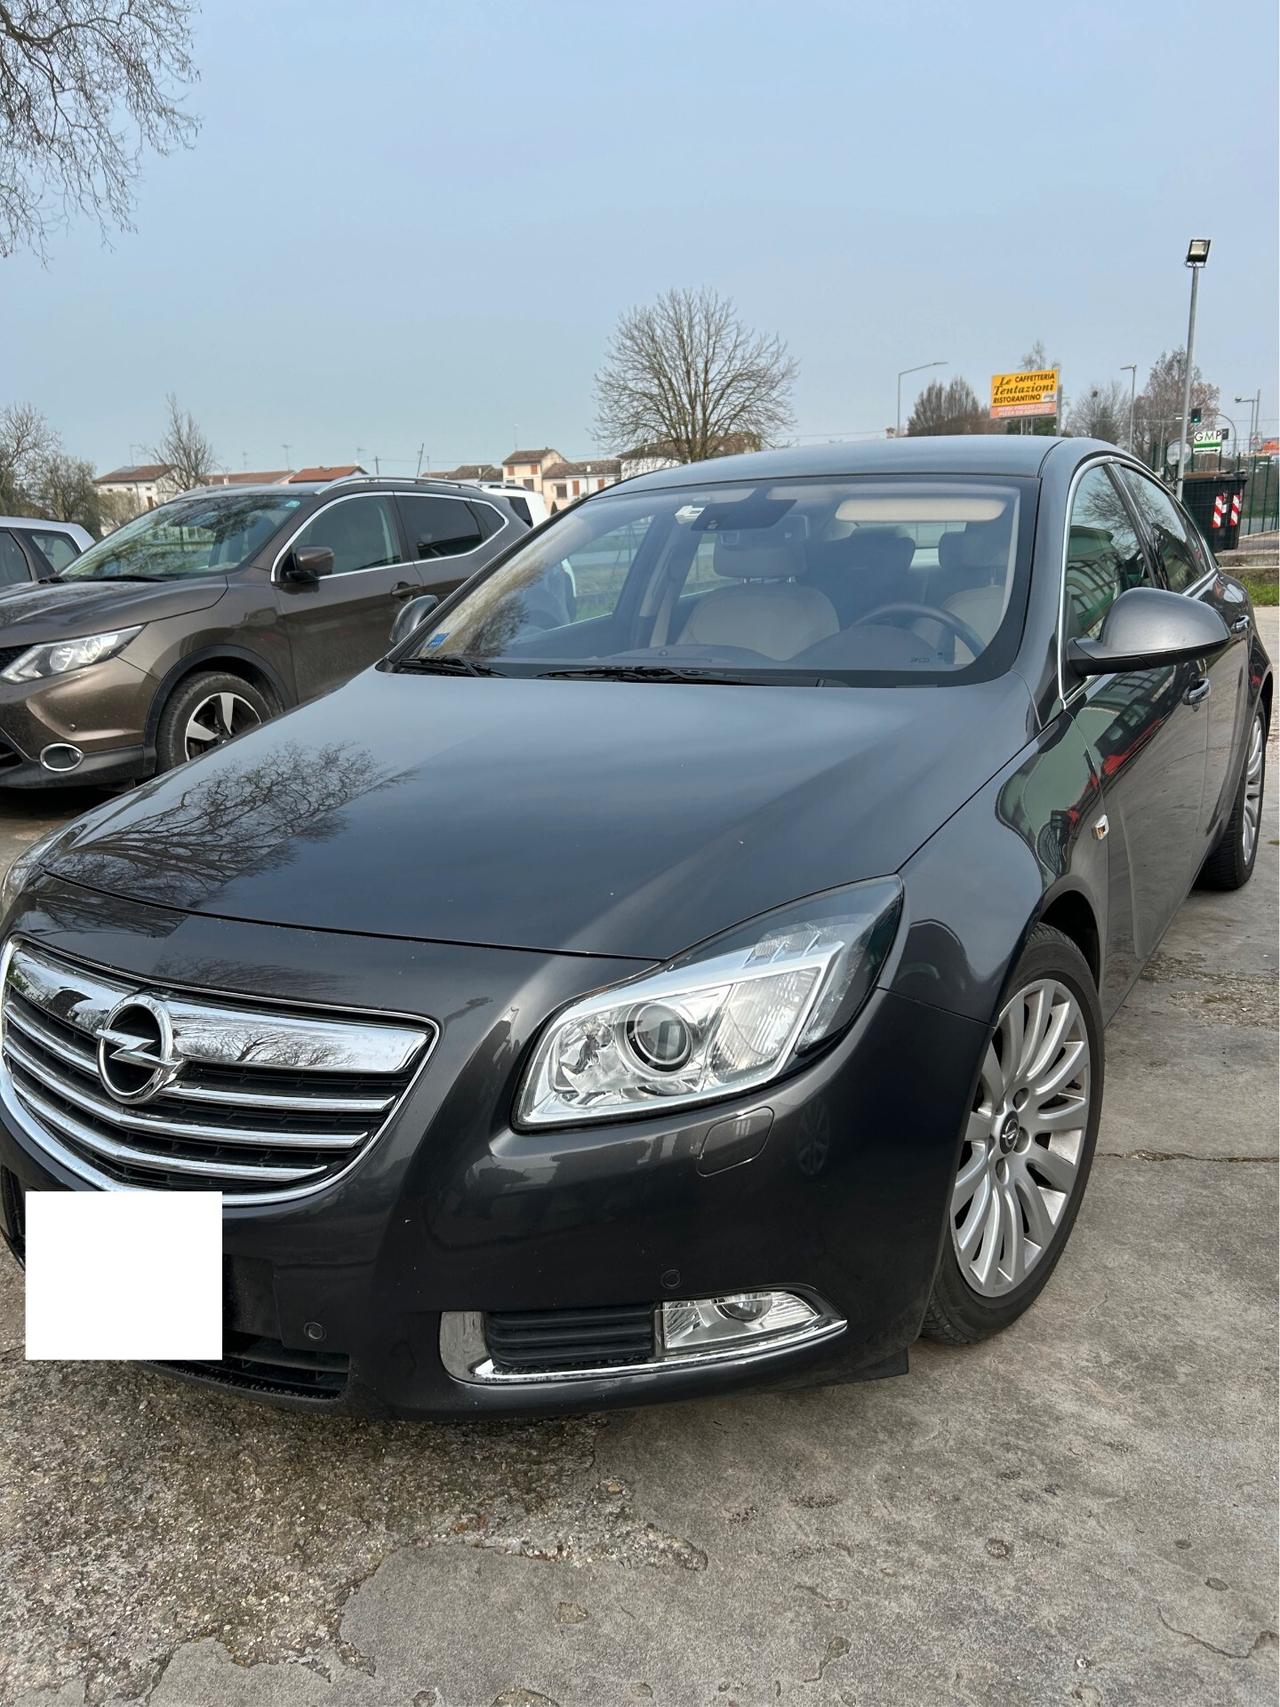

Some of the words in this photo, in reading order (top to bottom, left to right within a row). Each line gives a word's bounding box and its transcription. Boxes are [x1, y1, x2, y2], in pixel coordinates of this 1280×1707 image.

[999, 376, 1012, 385] Le
[1015, 373, 1055, 383] CAFFETTERIA
[993, 380, 1055, 396] Tentazioni
[993, 393, 1041, 404] RISTORANTINO
[1194, 430, 1222, 442] GMP
